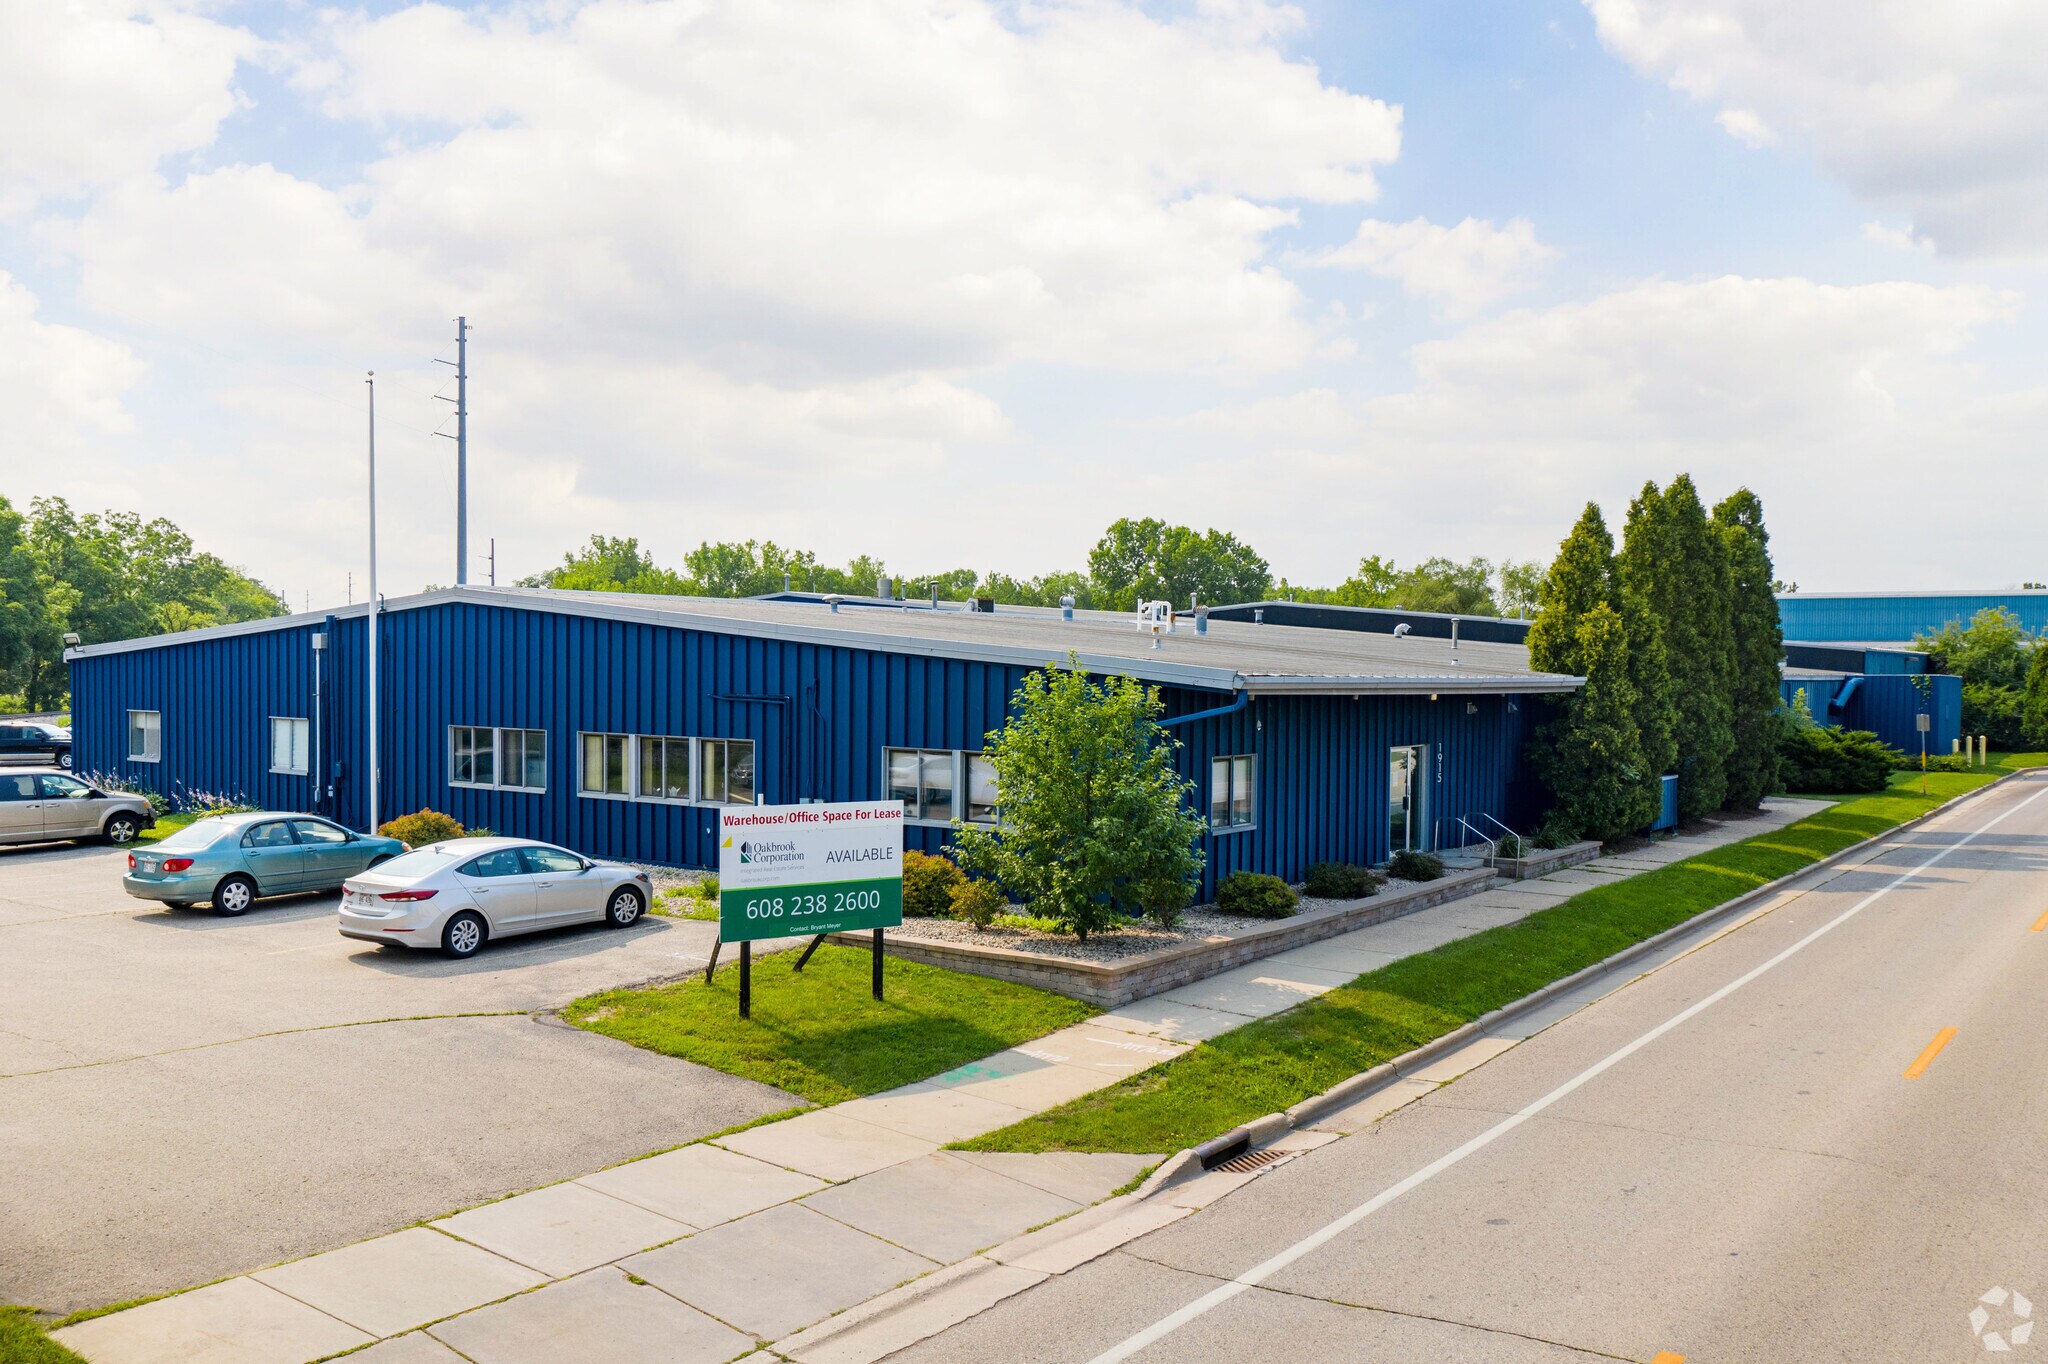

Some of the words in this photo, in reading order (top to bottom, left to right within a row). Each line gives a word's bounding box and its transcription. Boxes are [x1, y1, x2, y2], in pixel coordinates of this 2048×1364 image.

[723, 811, 820, 826] Warehouse/Office
[822, 811, 852, 824] Space
[855, 809, 871, 820] For
[874, 808, 902, 819] Lease
[753, 841, 796, 853] Oakbrook
[825, 847, 893, 864] AVAILABLE
[753, 851, 805, 864] Corporation
[746, 898, 784, 920] 608
[790, 894, 827, 916] 238
[833, 890, 880, 912] 2600
